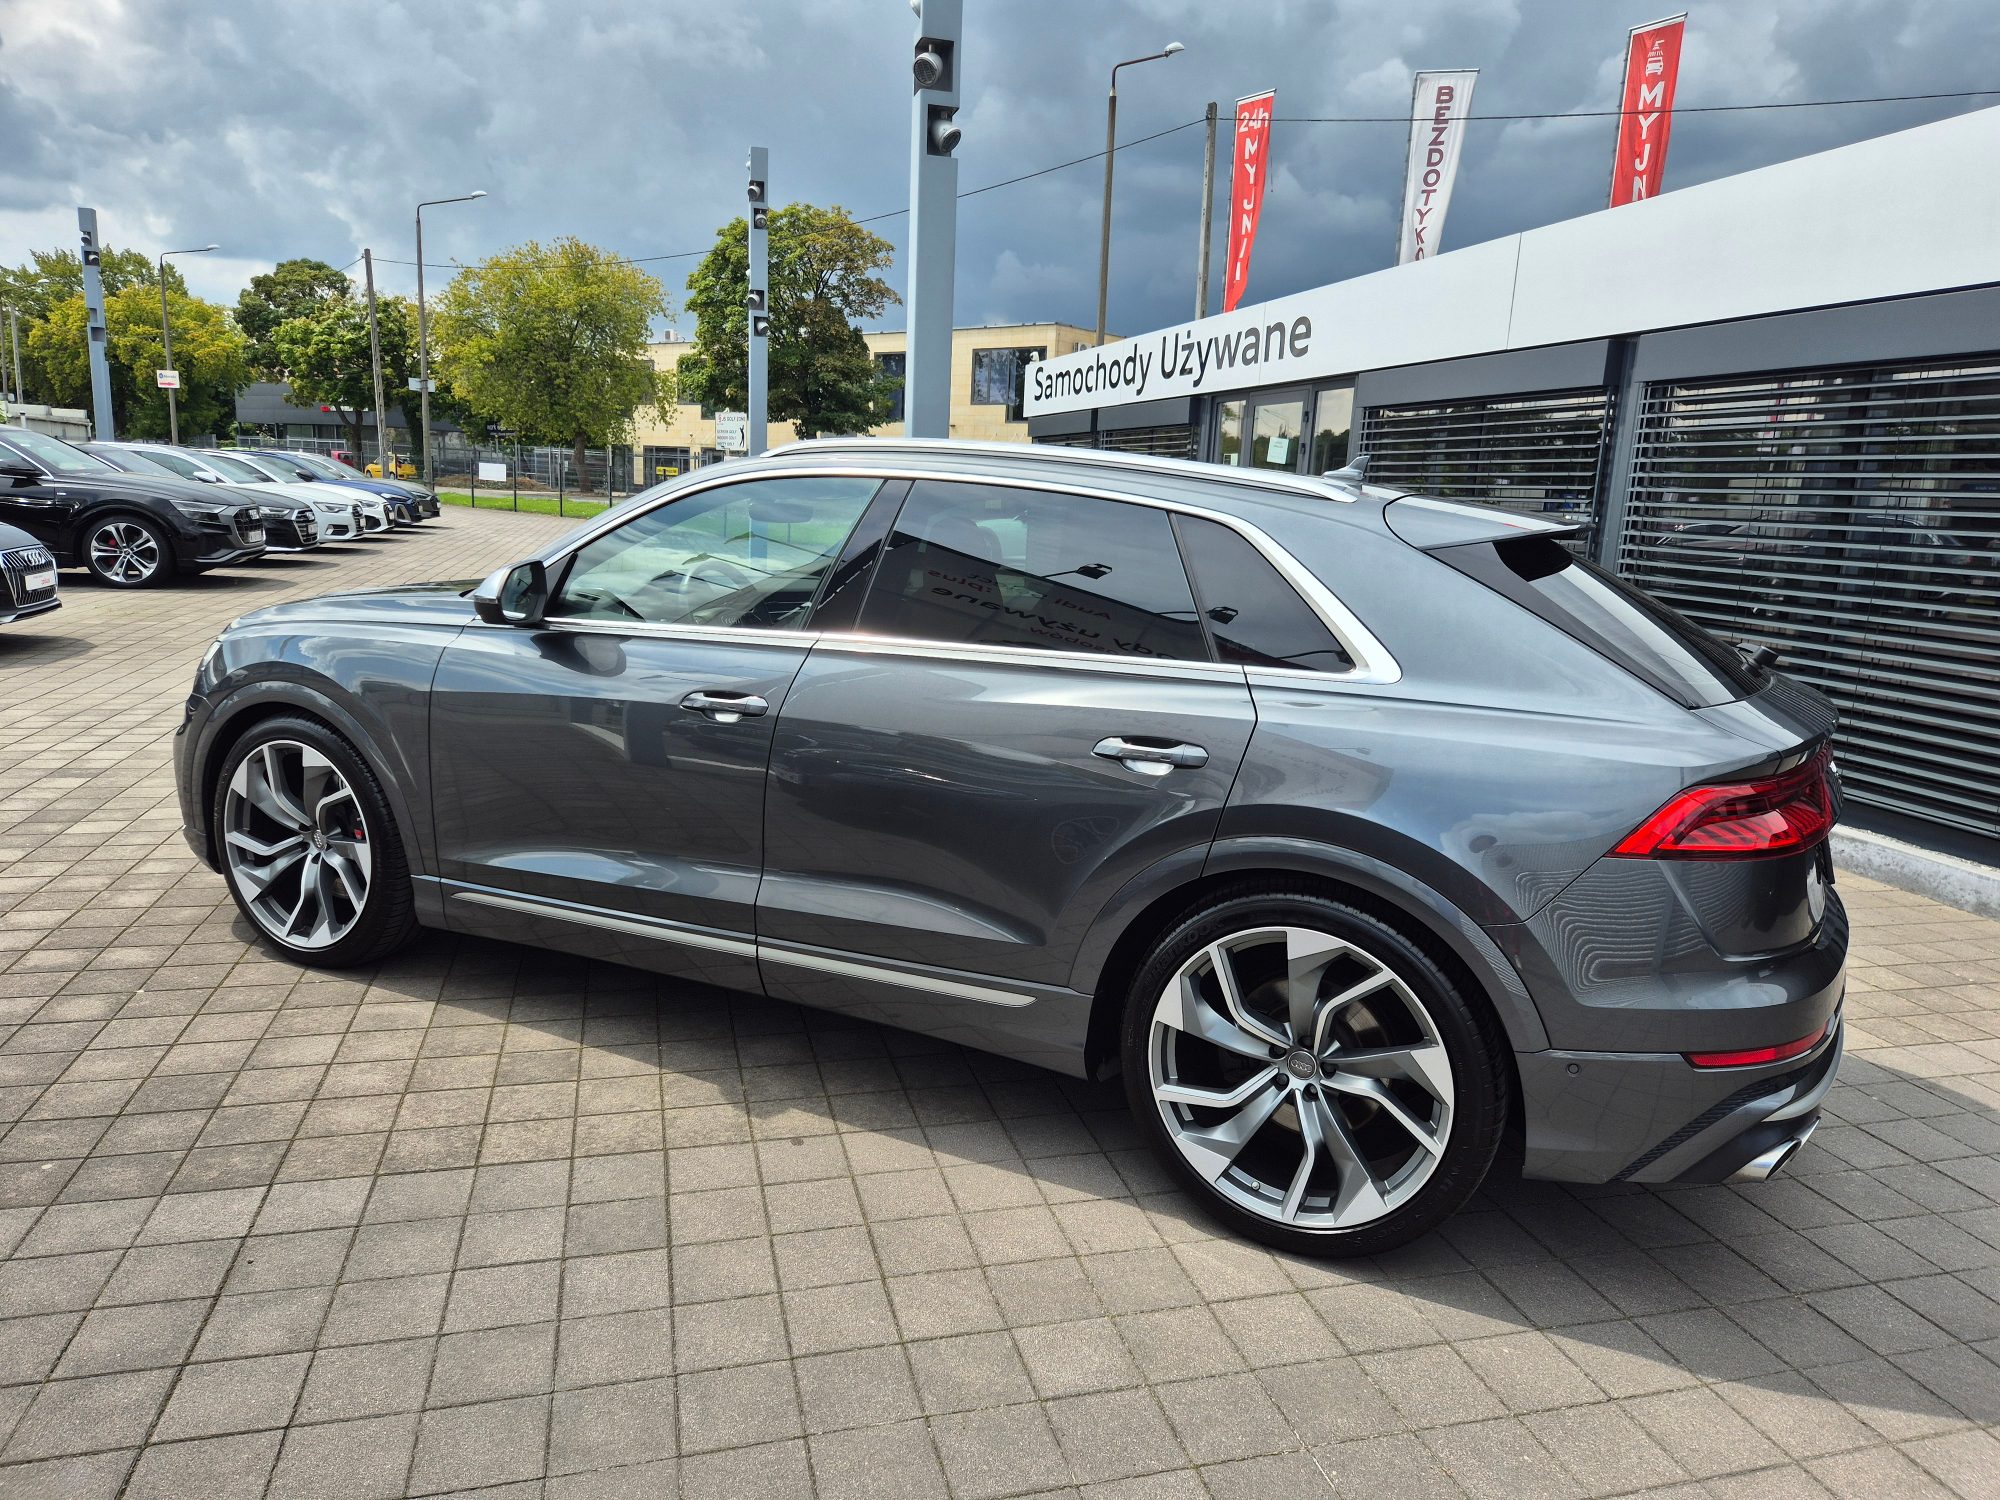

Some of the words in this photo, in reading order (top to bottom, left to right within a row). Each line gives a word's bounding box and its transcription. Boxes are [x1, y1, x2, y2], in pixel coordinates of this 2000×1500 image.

[1238, 107, 1270, 133] 24h
[1033, 342, 1153, 402] Samochody
[1160, 315, 1312, 388] Używane
